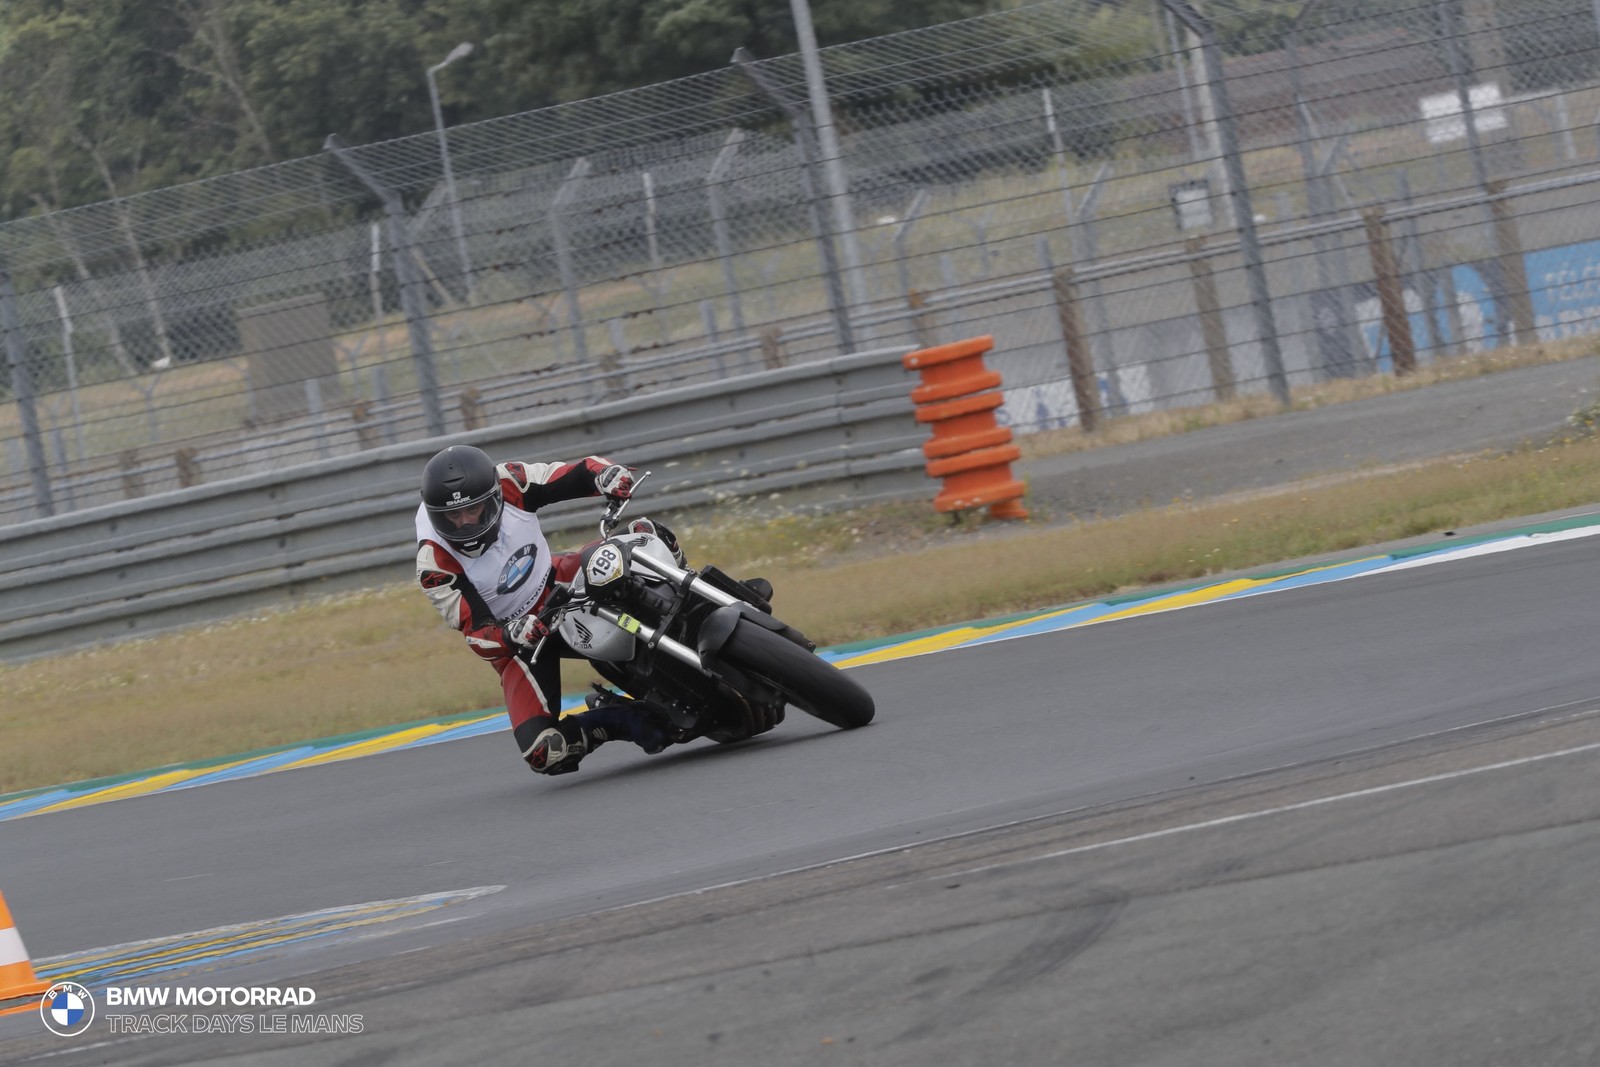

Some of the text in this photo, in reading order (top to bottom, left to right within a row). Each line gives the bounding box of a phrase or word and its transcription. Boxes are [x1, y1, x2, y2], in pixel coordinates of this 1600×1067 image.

[446, 496, 471, 506] SHARK
[499, 545, 532, 584] BMW
[592, 549, 617, 577] 198
